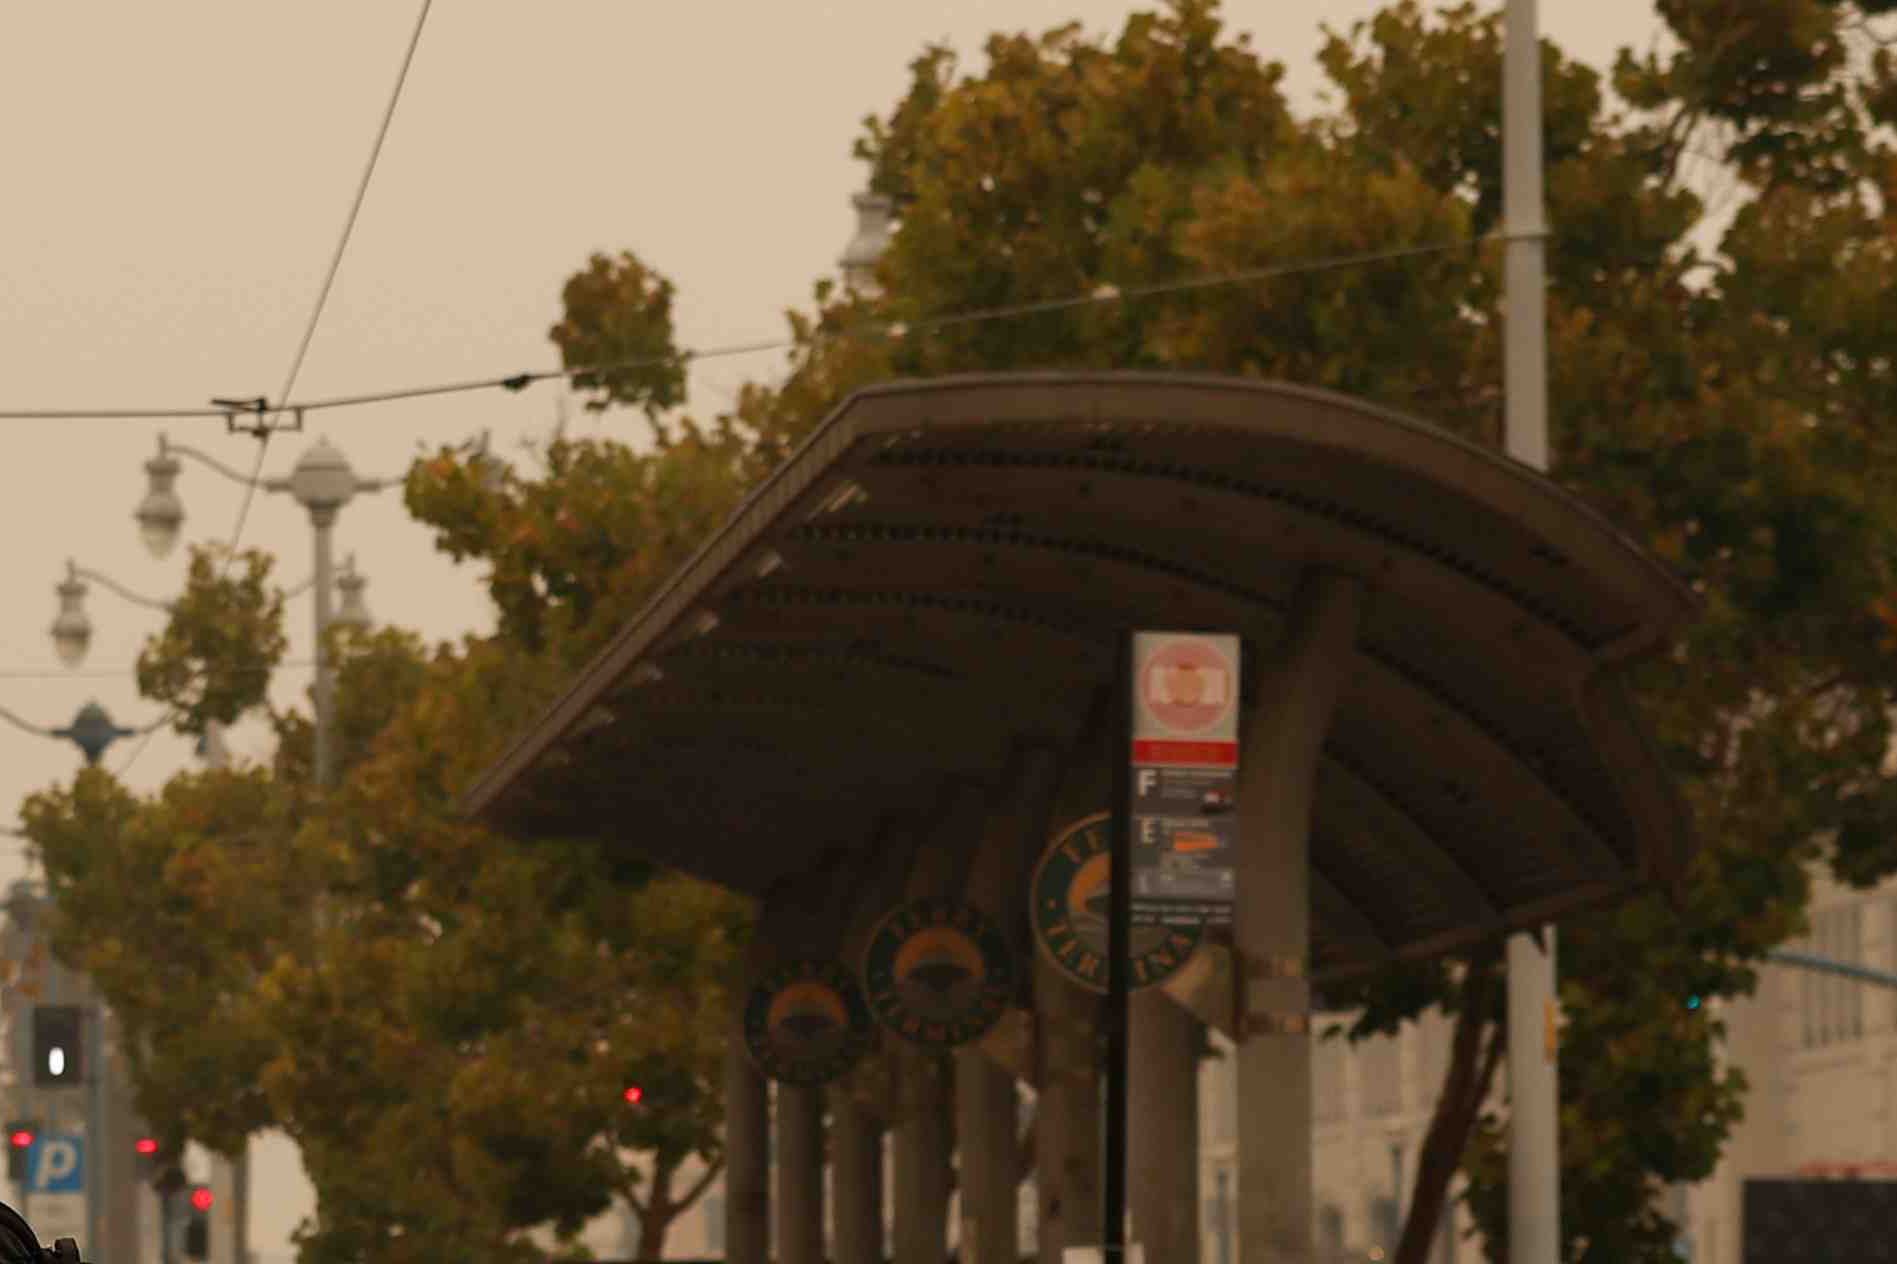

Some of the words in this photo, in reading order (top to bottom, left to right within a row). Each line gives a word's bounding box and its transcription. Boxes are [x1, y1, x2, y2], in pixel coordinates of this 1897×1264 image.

[1138, 768, 1157, 796] F
[1140, 816, 1156, 844] E
[36, 1141, 77, 1188] P
